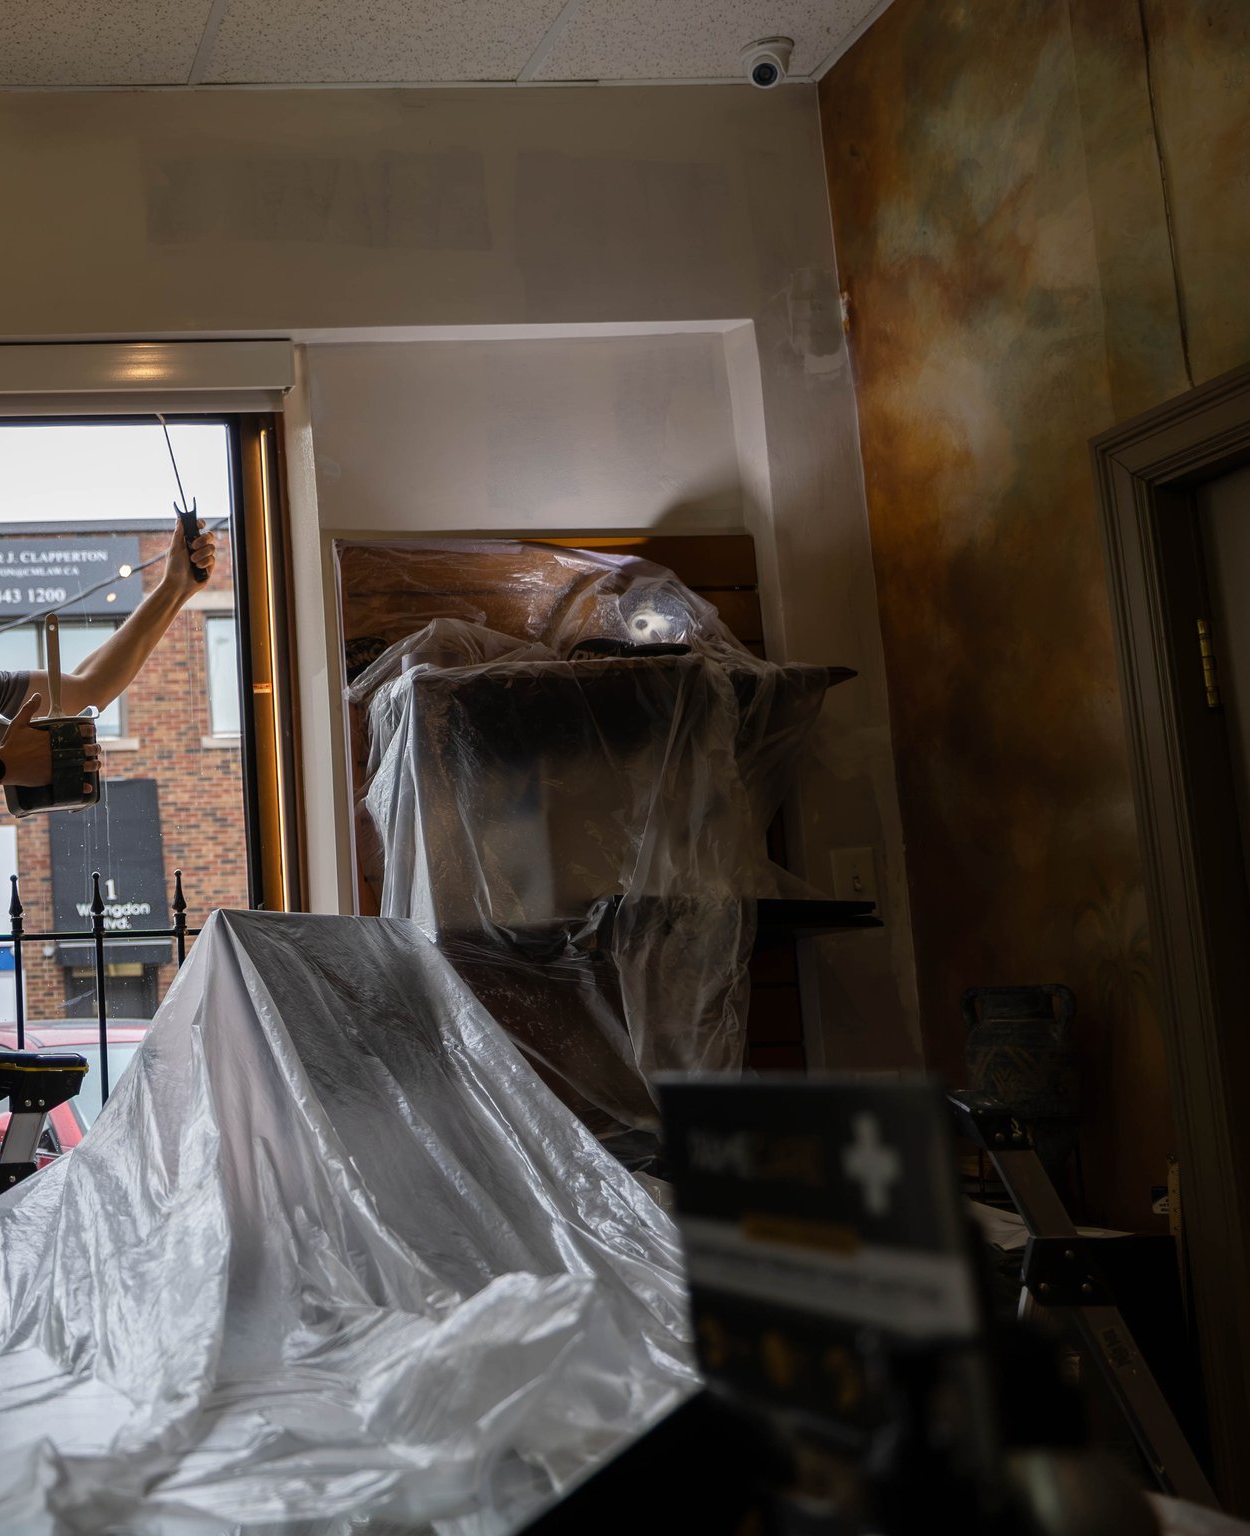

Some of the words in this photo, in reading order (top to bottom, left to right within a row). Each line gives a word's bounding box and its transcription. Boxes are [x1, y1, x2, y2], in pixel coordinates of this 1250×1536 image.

[19, 550, 109, 564] CLAPPERTON
[27, 587, 67, 603] 1200
[105, 879, 118, 900] 1
